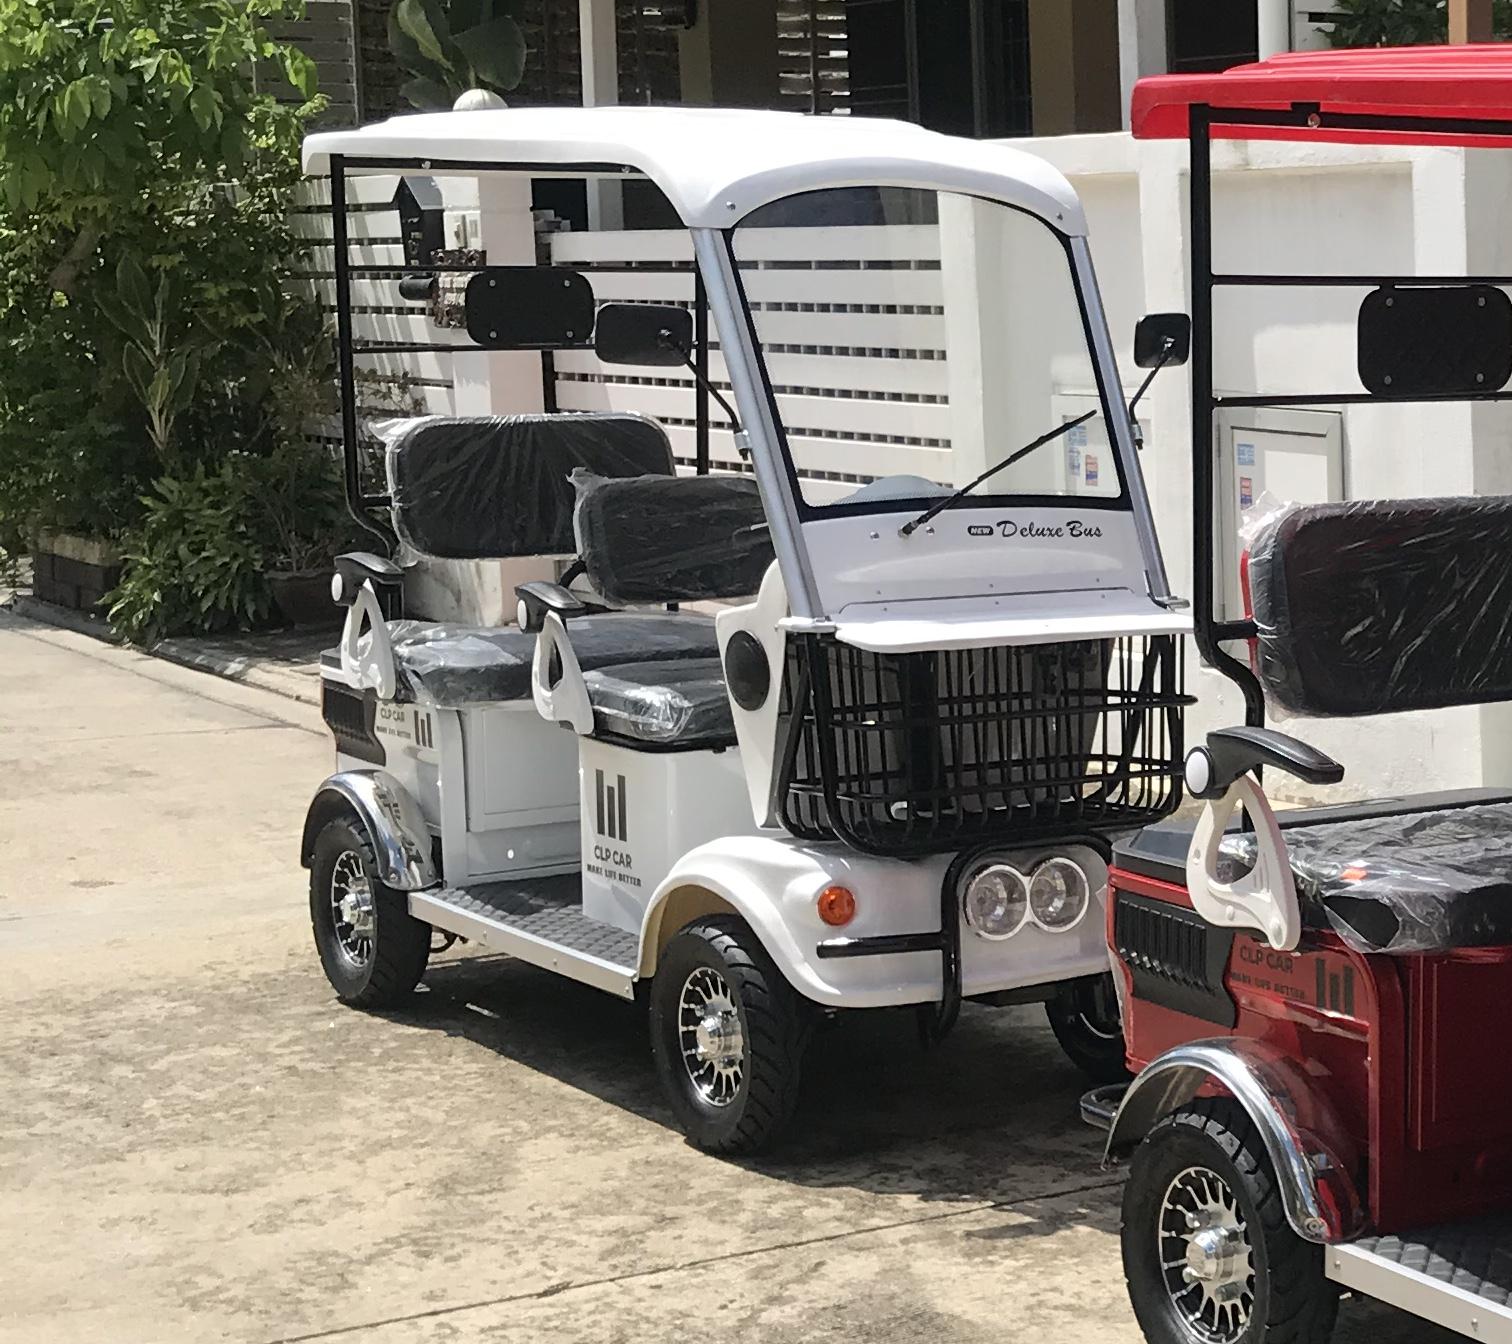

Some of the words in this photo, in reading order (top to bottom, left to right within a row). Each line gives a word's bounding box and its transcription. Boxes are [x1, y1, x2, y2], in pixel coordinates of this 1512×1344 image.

[969, 526, 991, 535] NEW
[996, 520, 1064, 537] Deluxe
[1066, 520, 1103, 537] Bus
[594, 845, 611, 862] CLP
[613, 850, 632, 870] CAR
[587, 863, 603, 876] MAKE
[618, 873, 641, 887] BETTER
[1239, 946, 1263, 965] CLP
